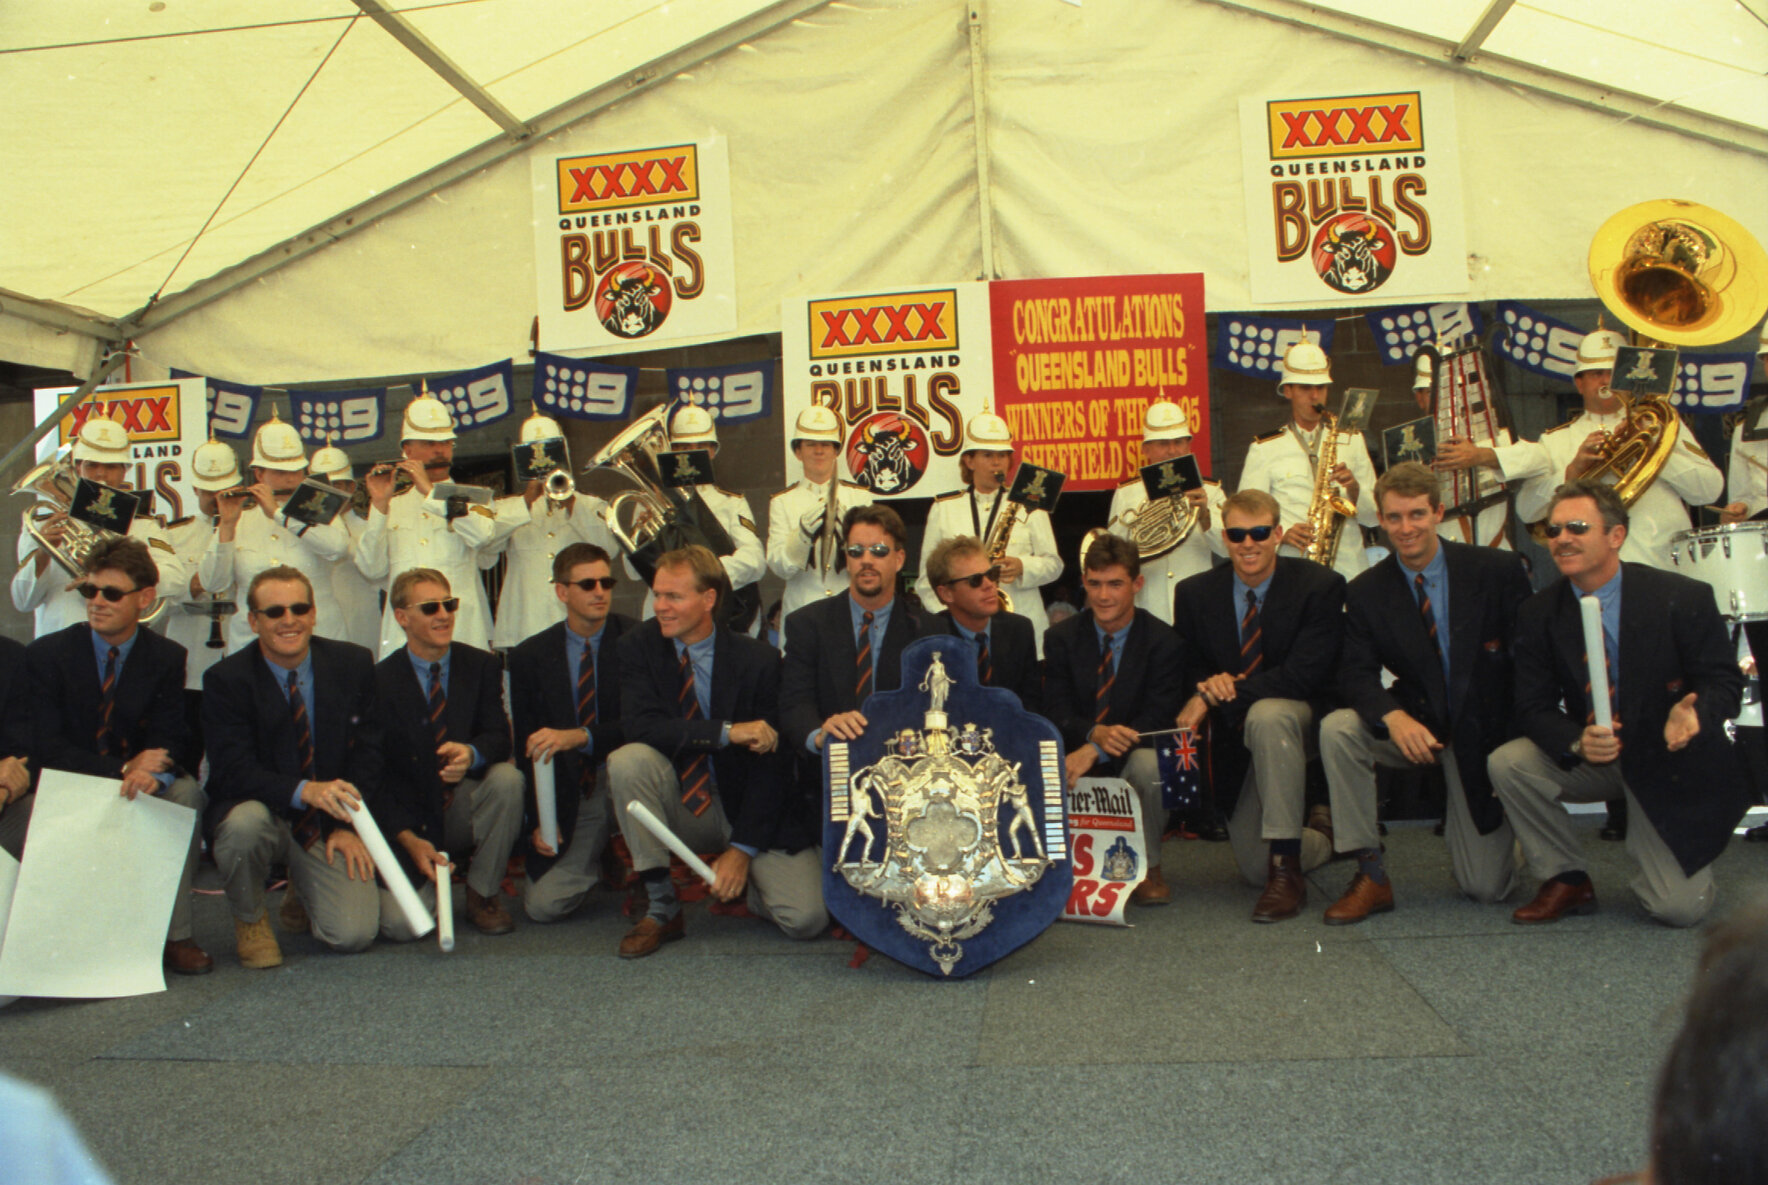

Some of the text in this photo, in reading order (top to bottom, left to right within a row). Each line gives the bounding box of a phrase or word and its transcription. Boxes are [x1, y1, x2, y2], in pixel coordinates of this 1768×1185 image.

[1280, 104, 1413, 149] XXXX
[568, 156, 689, 204] XXXX
[1270, 156, 1427, 177] QUEENSLAND
[558, 204, 701, 231] QUEENSLAND
[1272, 173, 1432, 263] BULLS
[560, 221, 705, 312] BULLS
[820, 302, 947, 348] XXXX
[1013, 293, 1185, 344] CONGRATULATIONS
[809, 354, 960, 377] QUEENSLAND
[1701, 361, 1748, 407] 9
[467, 373, 509, 423] 9
[583, 372, 628, 415] 9
[722, 371, 764, 418] 9
[341, 397, 379, 440] 9
[1005, 400, 1086, 441] WINNERS
[1089, 399, 1111, 438] OF
